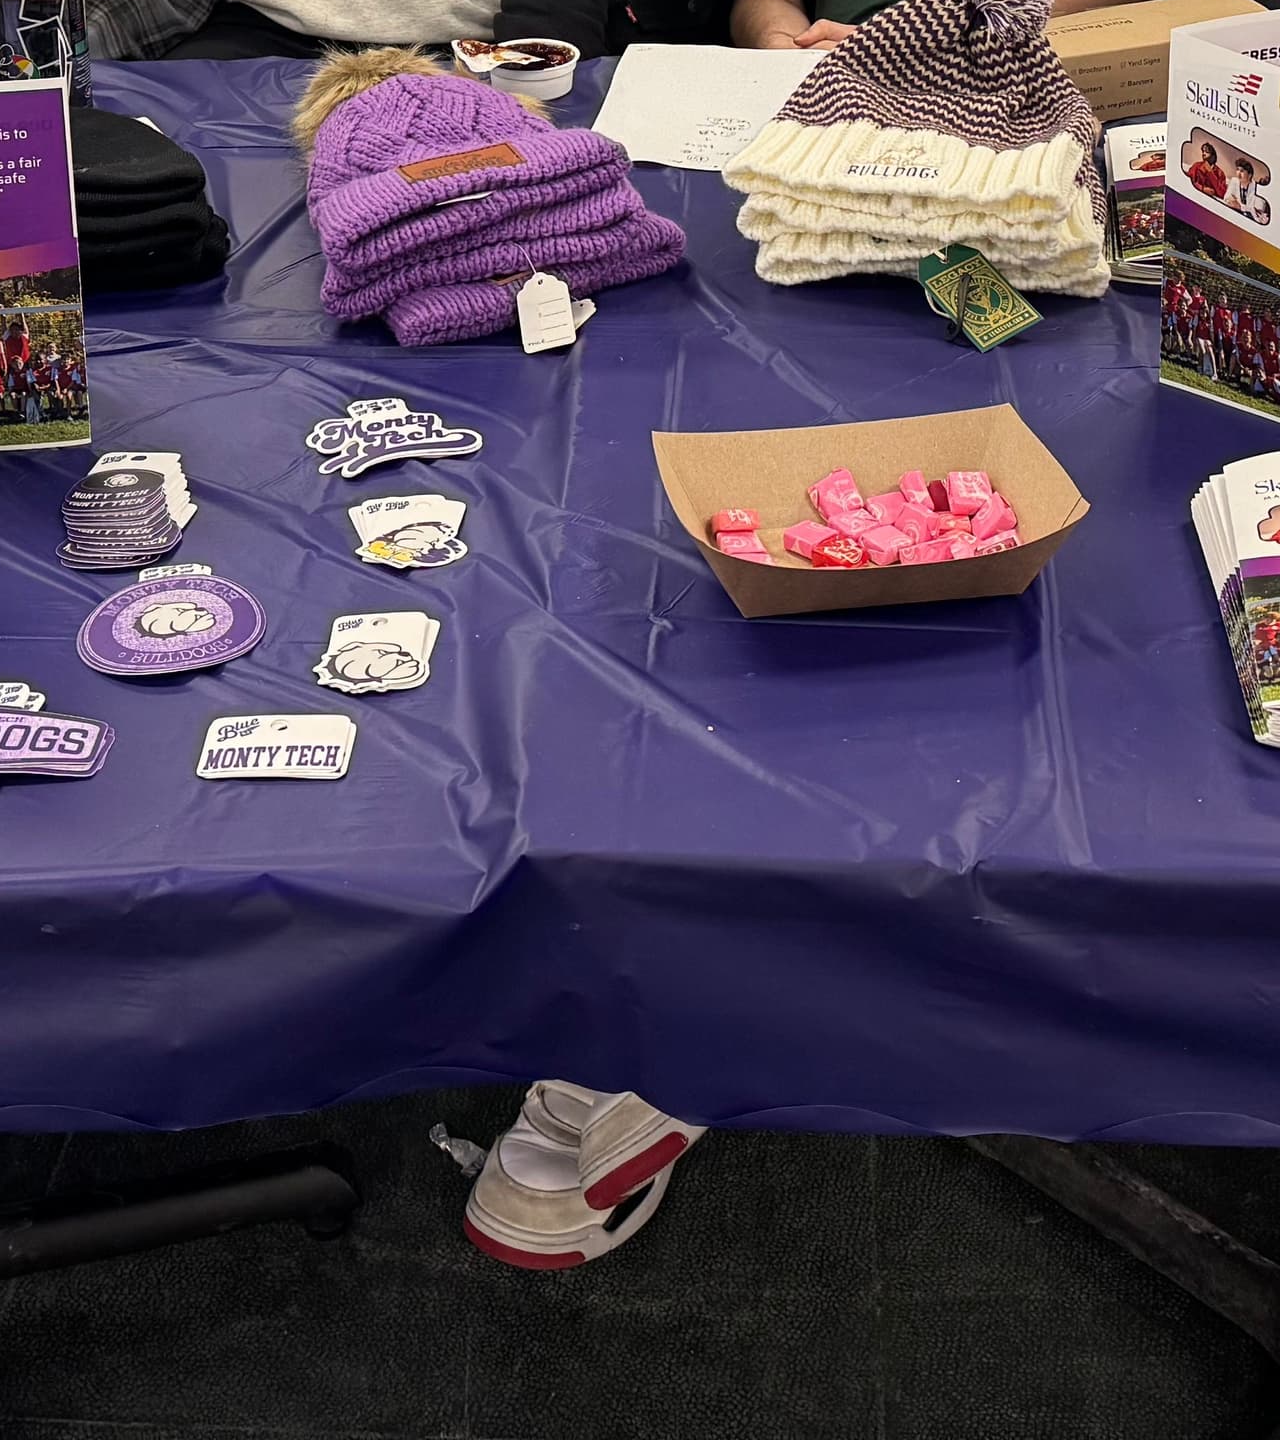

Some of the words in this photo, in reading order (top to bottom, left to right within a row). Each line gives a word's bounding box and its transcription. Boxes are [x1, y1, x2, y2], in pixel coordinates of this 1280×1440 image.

[1127, 78, 1154, 87] Banners
[1186, 80, 1261, 128] SkillsUSA
[0, 128, 10, 141] is
[14, 128, 28, 139] to
[1190, 108, 1256, 138] MASSACHUSETTS
[7, 160, 15, 169] a
[19, 156, 42, 169] fair
[932, 258, 982, 289] LEGACY
[321, 414, 435, 450] Monty
[111, 498, 146, 507] TECH
[115, 489, 150, 499] TECH
[99, 580, 180, 619] MONTY
[186, 580, 242, 602] TECH
[130, 640, 228, 664] BULLDOGS
[217, 718, 260, 742] Blue
[203, 746, 281, 770] MONTY
[285, 745, 340, 767] TECH
